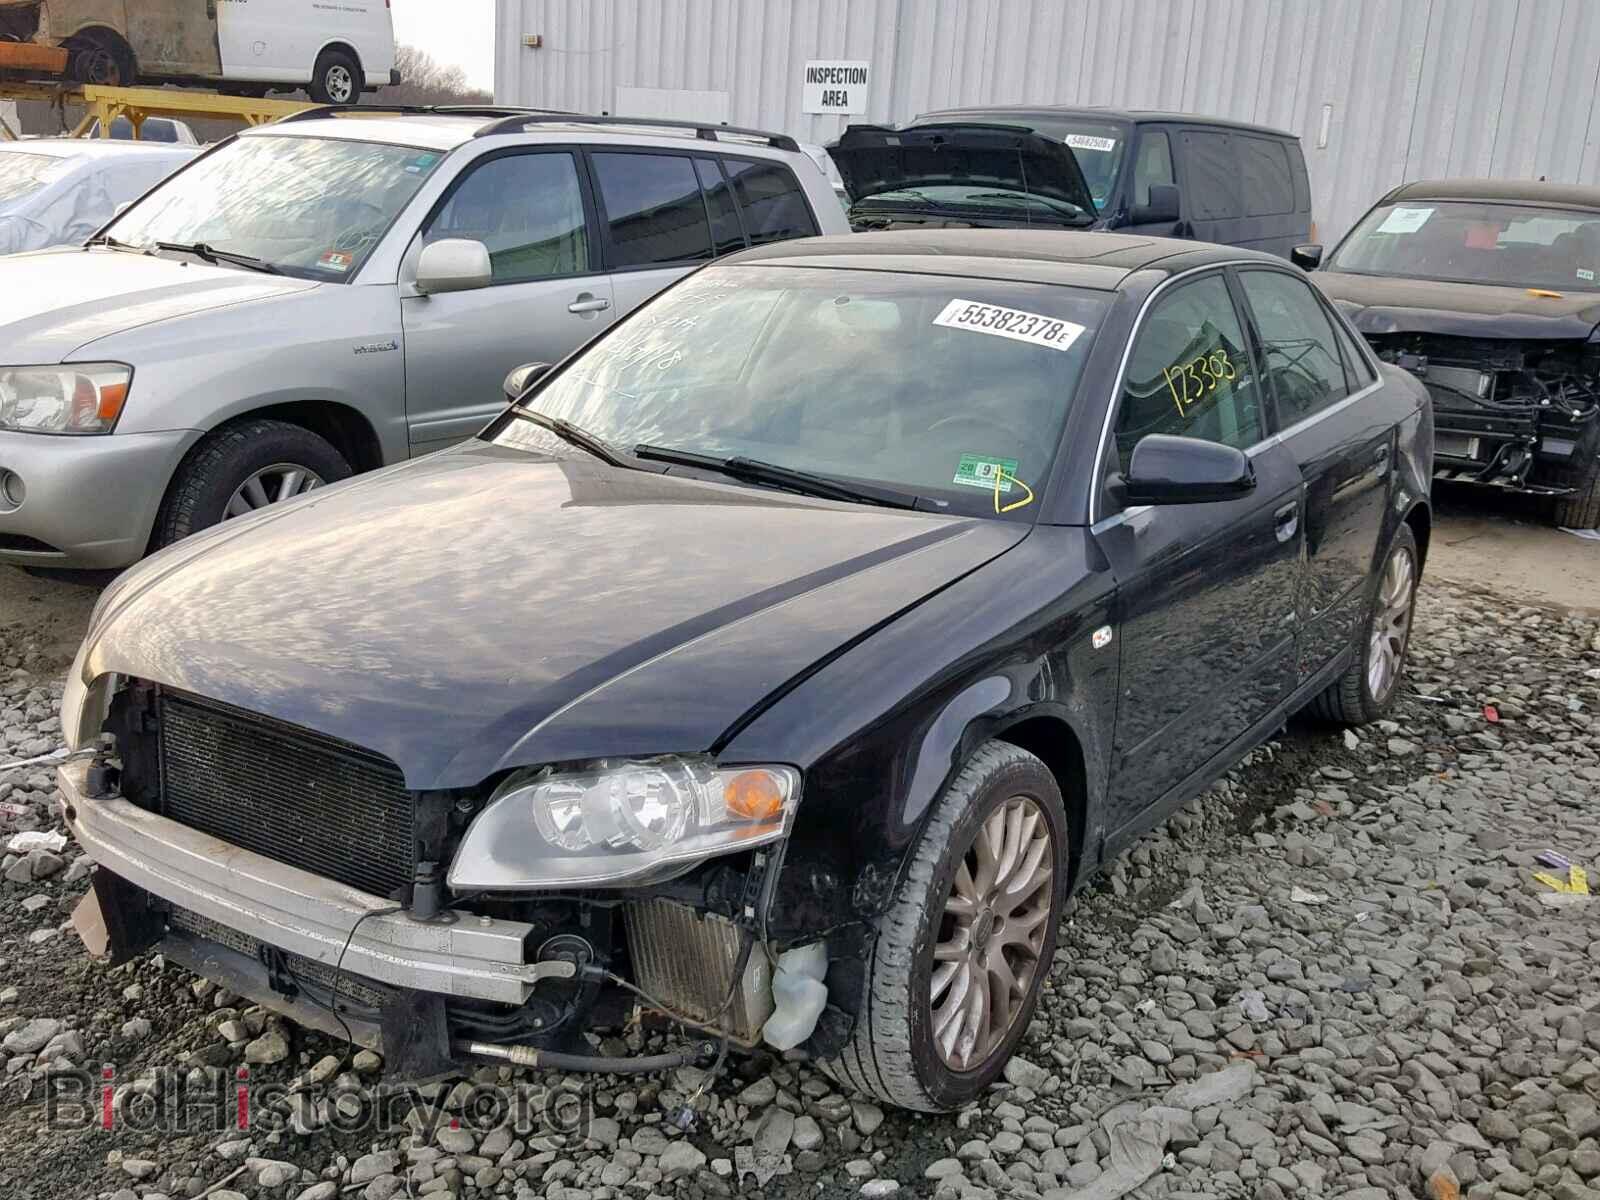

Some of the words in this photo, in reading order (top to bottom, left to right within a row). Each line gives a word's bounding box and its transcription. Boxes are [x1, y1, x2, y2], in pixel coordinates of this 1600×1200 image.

[806, 67, 868, 84] INSPECTION
[821, 90, 848, 107] AREA
[1162, 349, 1237, 418] 123303
[981, 464, 992, 476] 9
